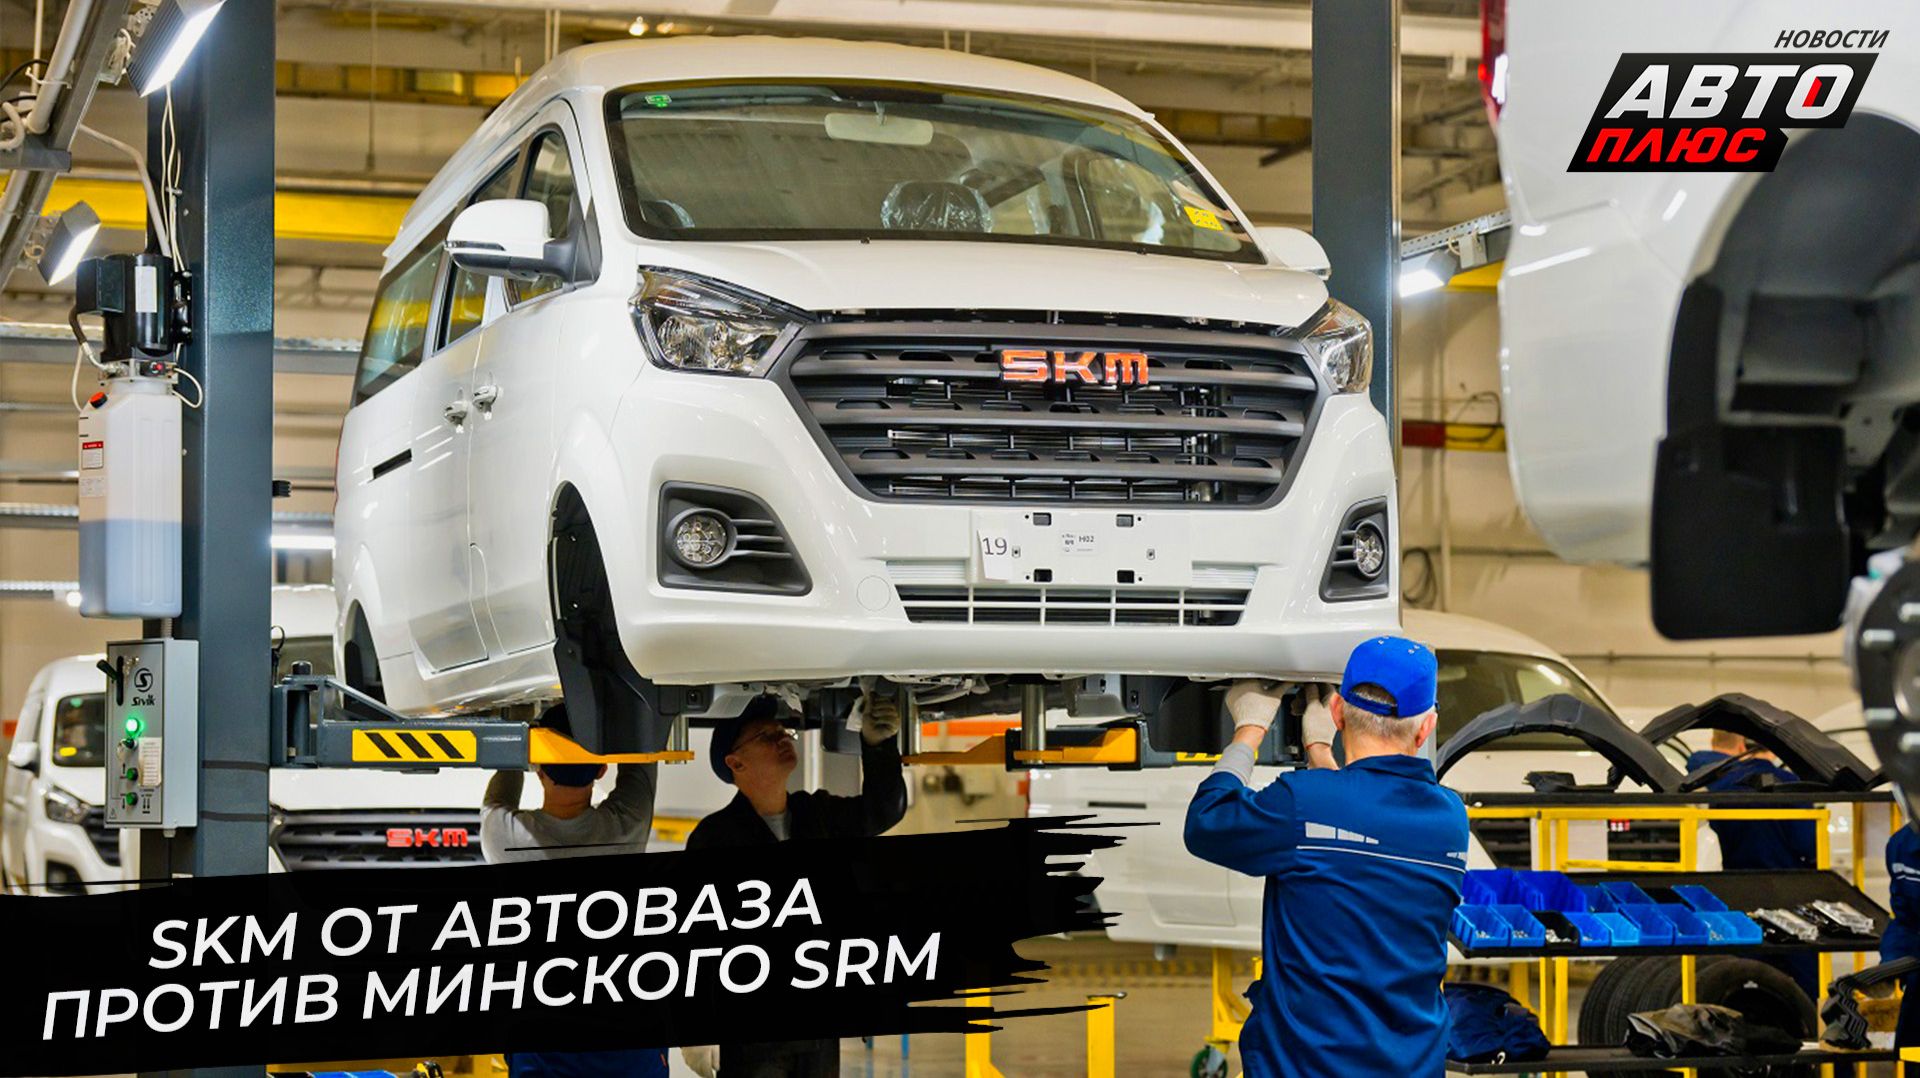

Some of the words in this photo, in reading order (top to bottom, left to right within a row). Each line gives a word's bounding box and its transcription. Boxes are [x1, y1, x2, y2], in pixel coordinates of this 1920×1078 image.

[1002, 350, 1148, 384] SKM
[982, 537, 1007, 556] 19
[386, 828, 468, 847] SKM
